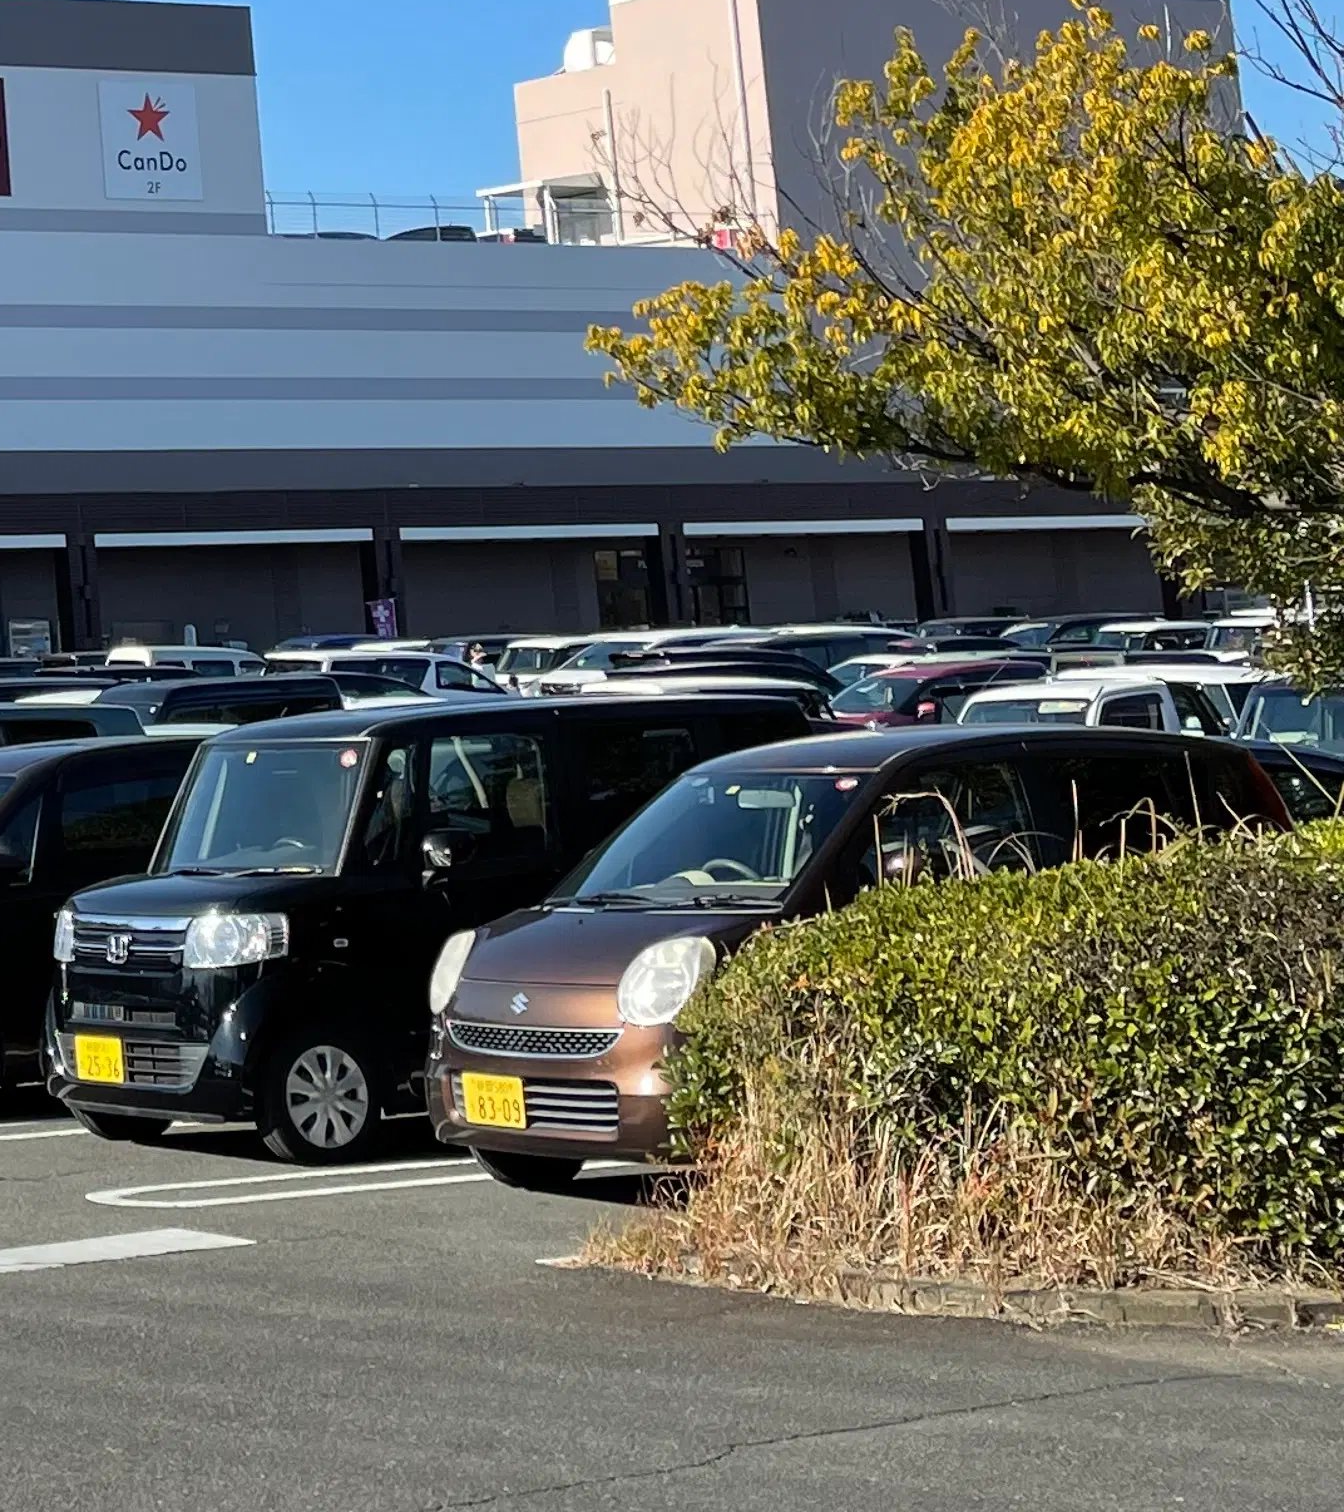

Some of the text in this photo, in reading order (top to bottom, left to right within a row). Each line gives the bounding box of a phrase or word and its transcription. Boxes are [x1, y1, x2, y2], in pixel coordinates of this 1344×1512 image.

[118, 149, 187, 172] CanDo
[147, 181, 161, 194] 2F
[478, 1095, 521, 1124] 83-09
